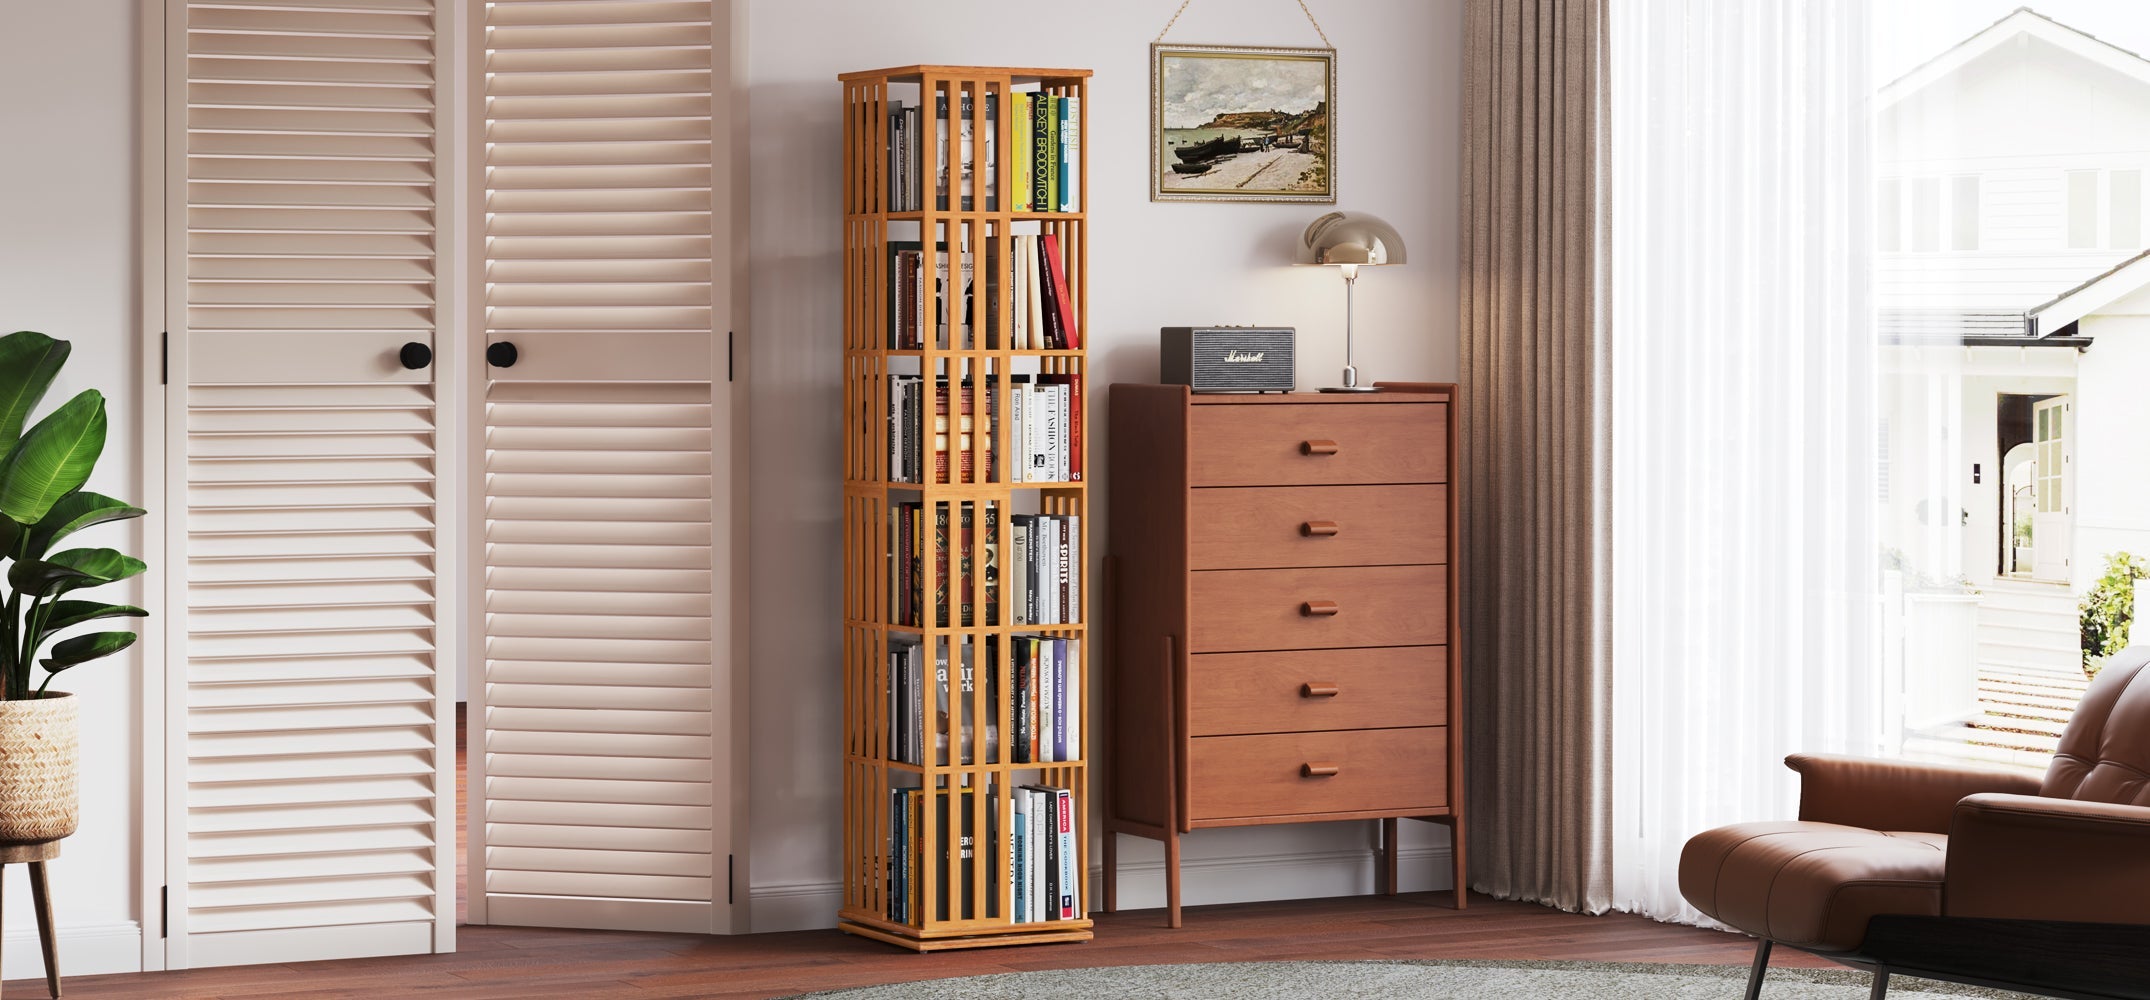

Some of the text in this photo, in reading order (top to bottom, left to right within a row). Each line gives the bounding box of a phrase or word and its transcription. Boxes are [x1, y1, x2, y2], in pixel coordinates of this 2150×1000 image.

[1036, 94, 1047, 204] ALEXEY BRODOVITCH
[1224, 350, 1264, 363] Marshall
[1060, 543, 1068, 584] SPIRITS
